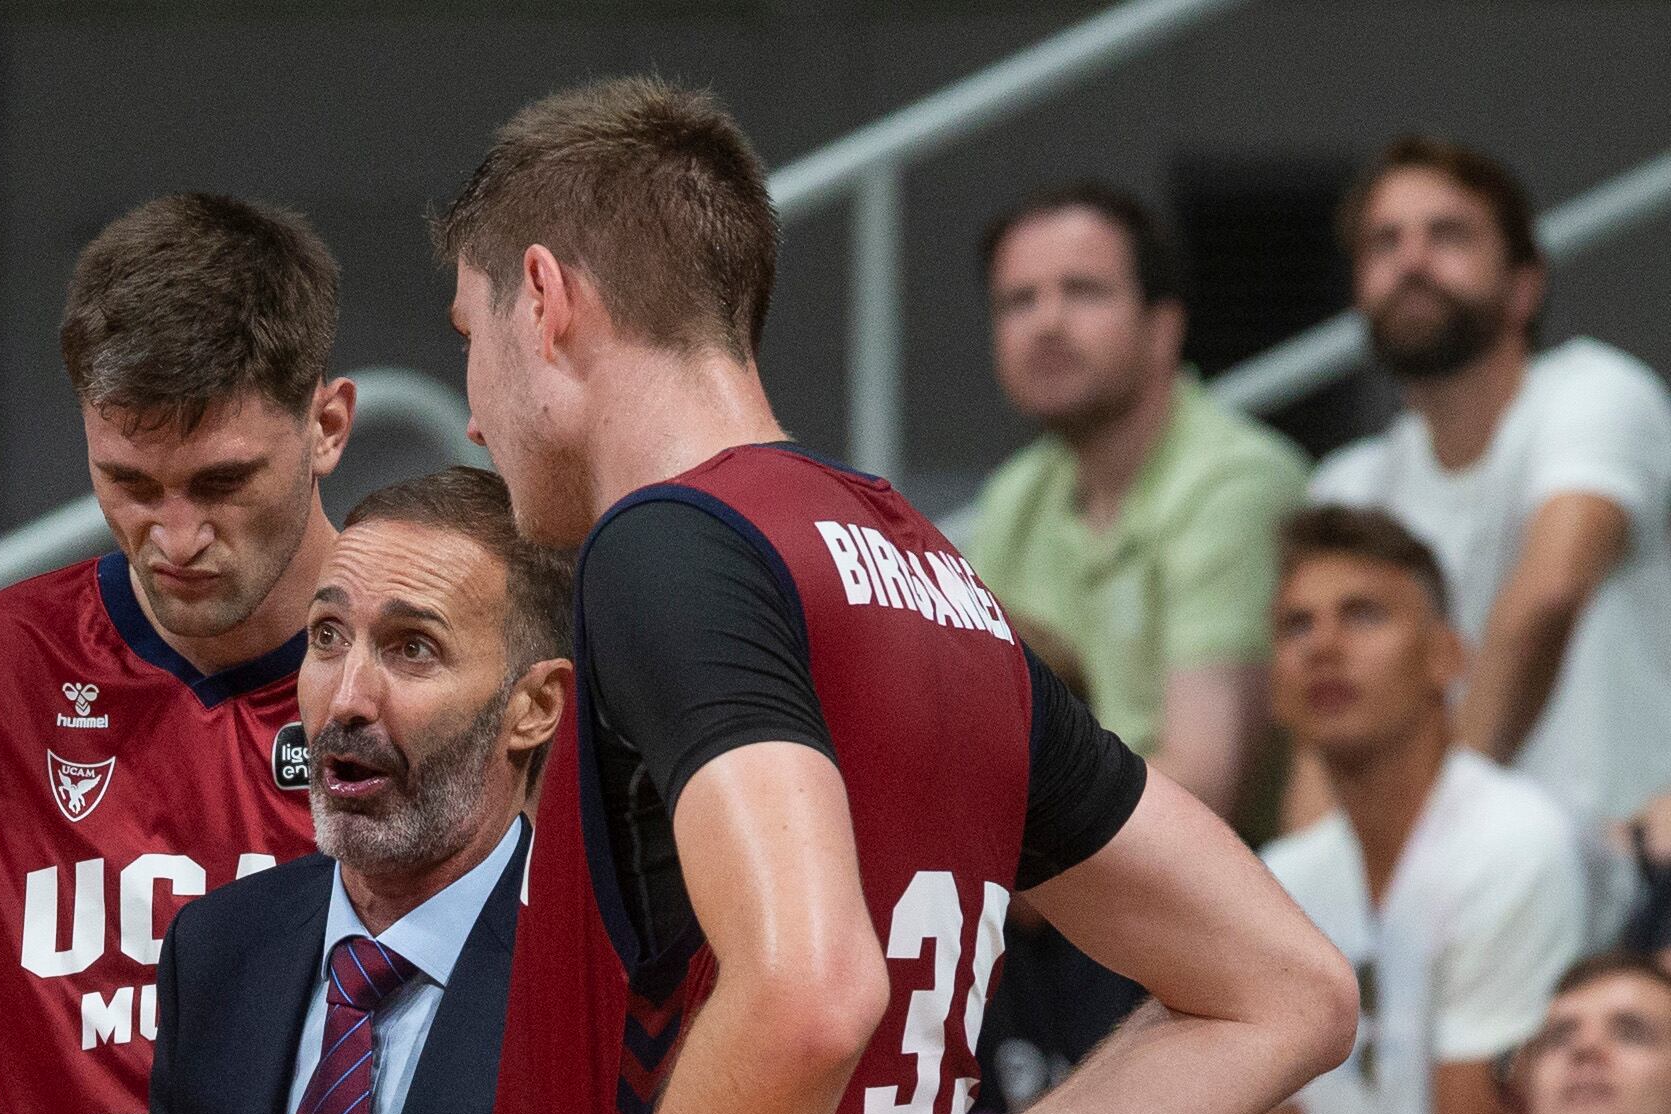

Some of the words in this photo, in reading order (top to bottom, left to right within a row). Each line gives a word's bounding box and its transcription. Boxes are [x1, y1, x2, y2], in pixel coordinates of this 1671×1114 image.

[814, 521, 1015, 645] BIRGANE
[57, 713, 108, 728] hummel
[62, 765, 95, 778] UCAM
[21, 853, 276, 978] UC
